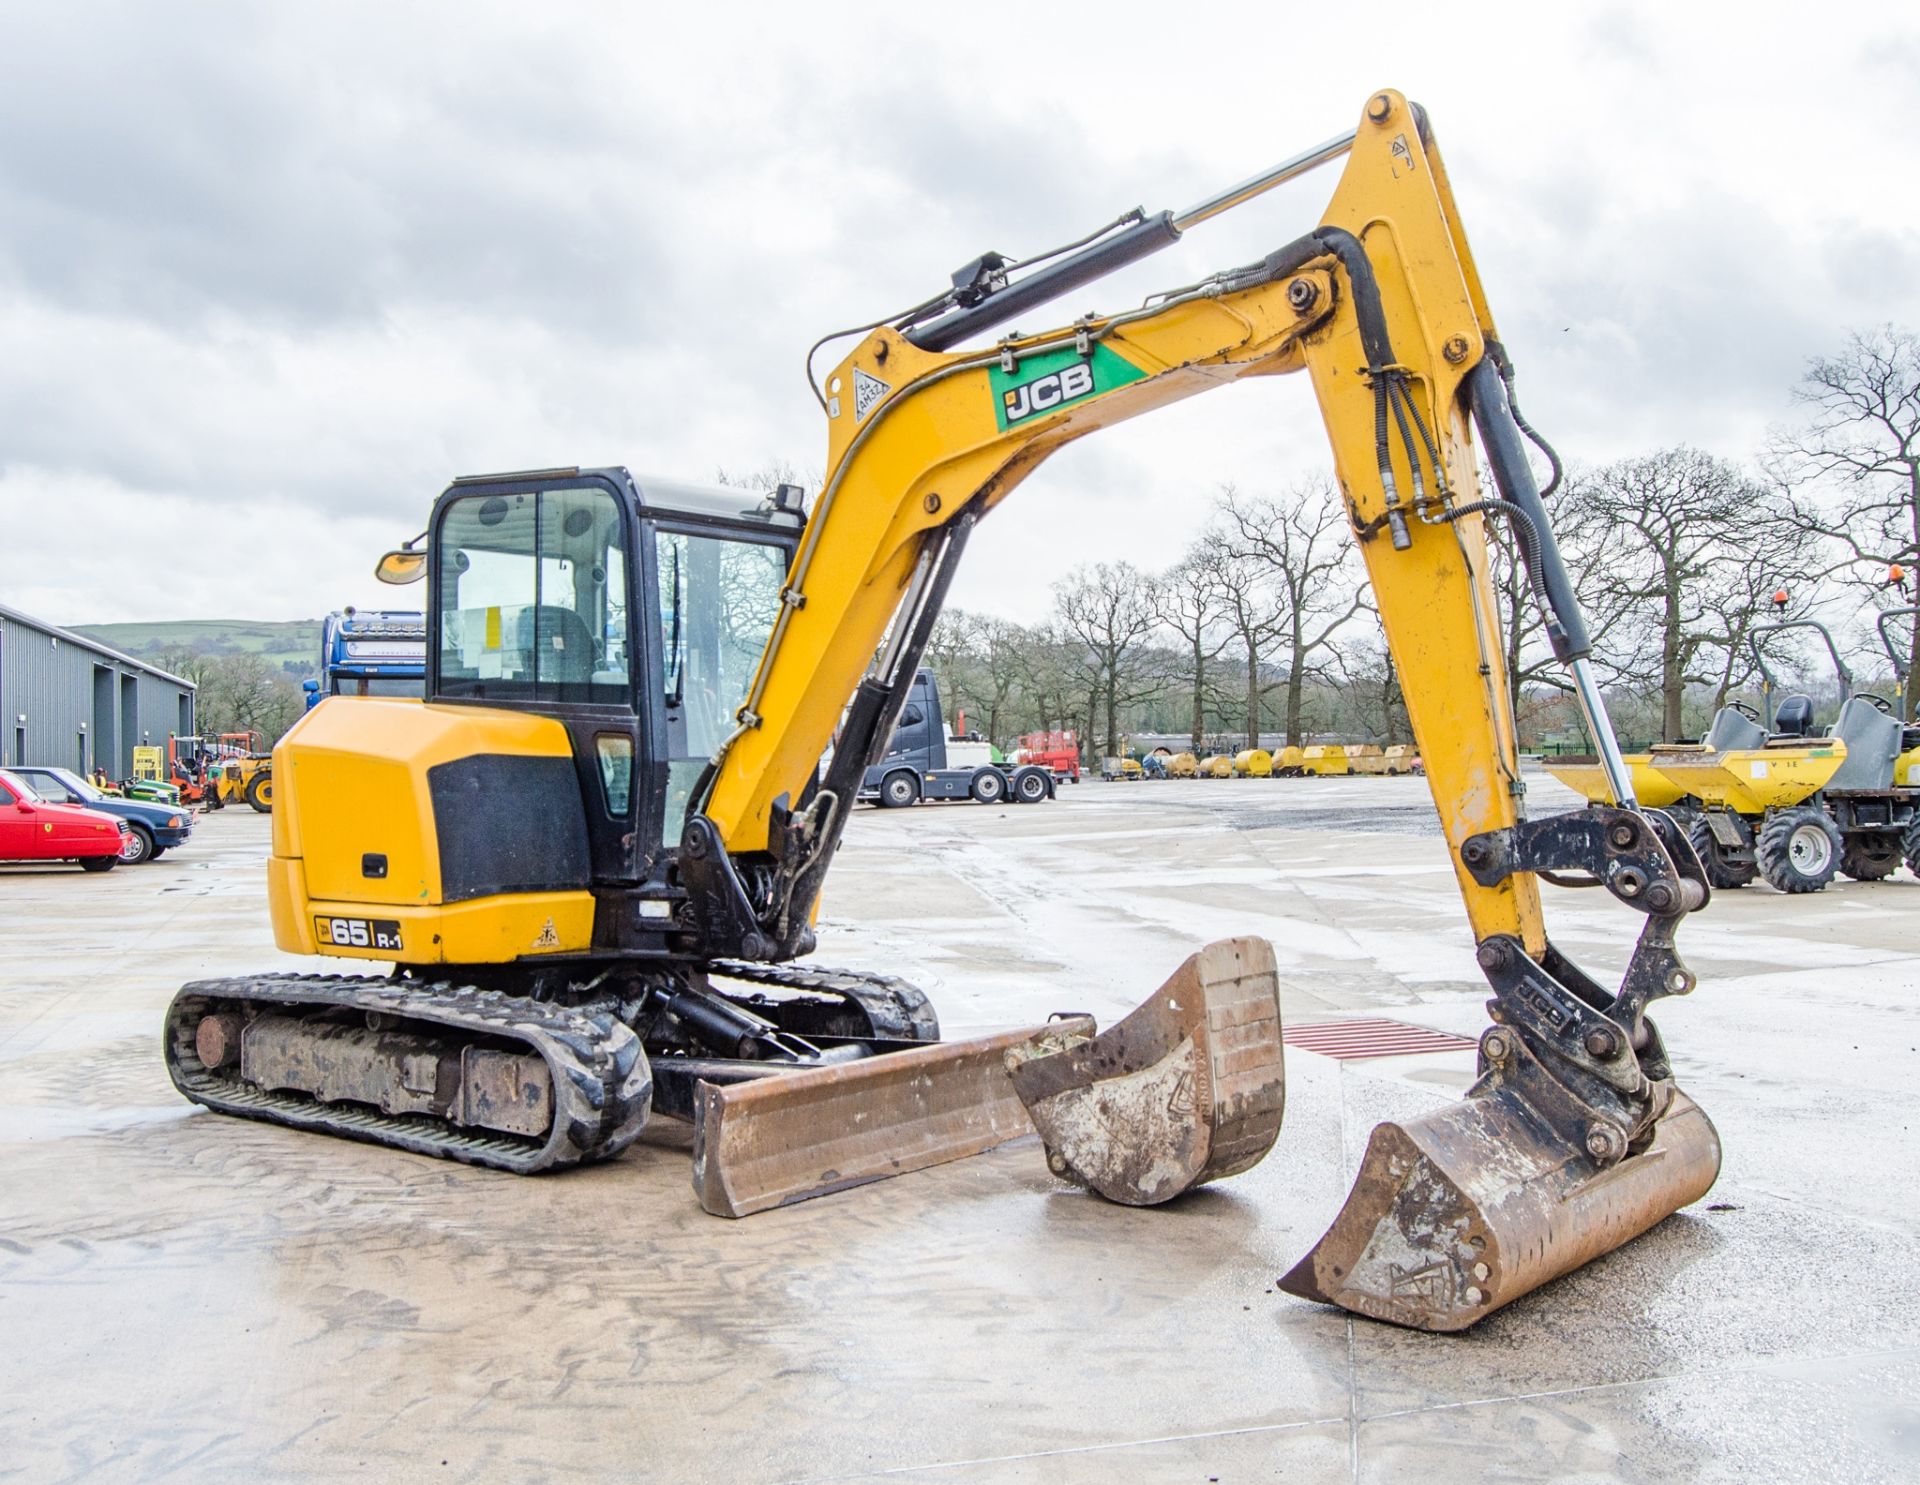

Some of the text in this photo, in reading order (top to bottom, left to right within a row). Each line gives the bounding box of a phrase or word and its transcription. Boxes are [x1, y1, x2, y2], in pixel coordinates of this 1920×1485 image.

[1006, 363, 1093, 420] JCB
[331, 918, 369, 946] 65
[377, 933, 402, 949] R-1
[1517, 979, 1566, 1028] JCB
